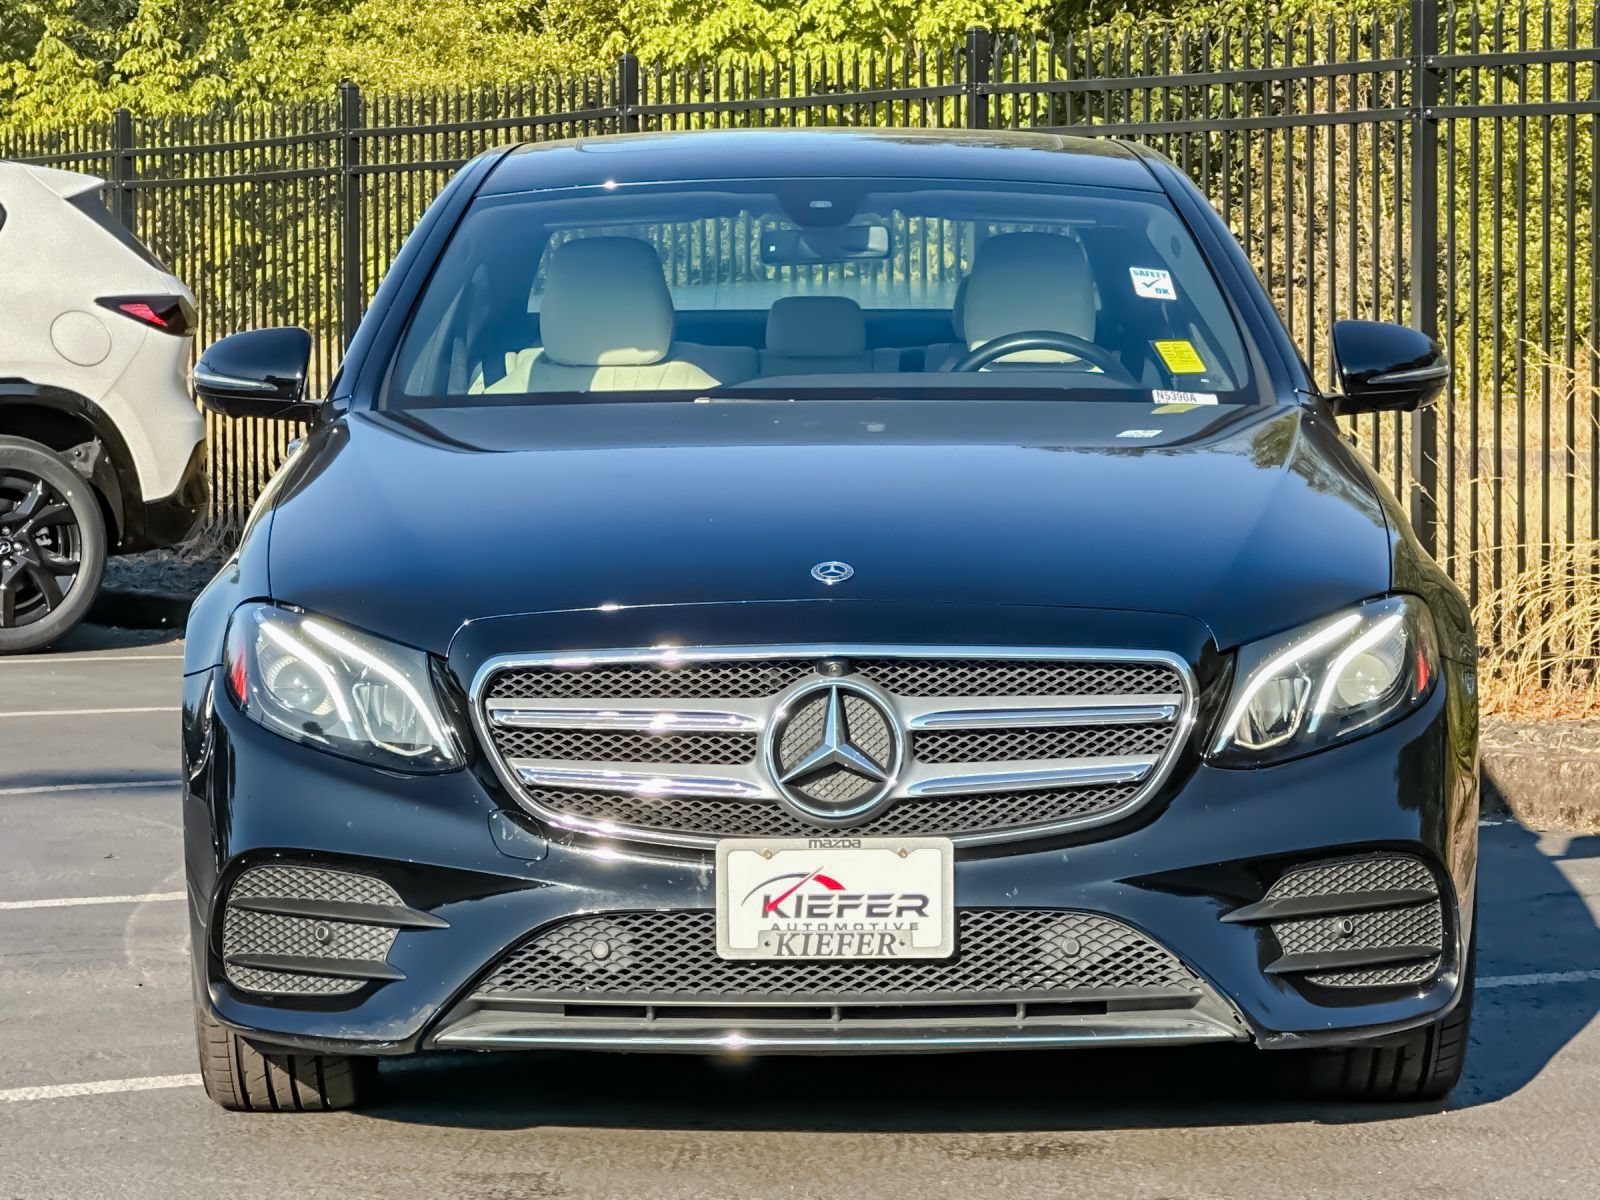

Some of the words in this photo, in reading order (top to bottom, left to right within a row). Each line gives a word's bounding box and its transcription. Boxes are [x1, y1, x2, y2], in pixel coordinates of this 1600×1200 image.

[1133, 270, 1167, 279] SAFETY
[1155, 287, 1170, 295] OK
[761, 893, 930, 919] KIEFER
[770, 922, 920, 931] AUTOMOTIVE
[773, 932, 899, 957] KIEFER
